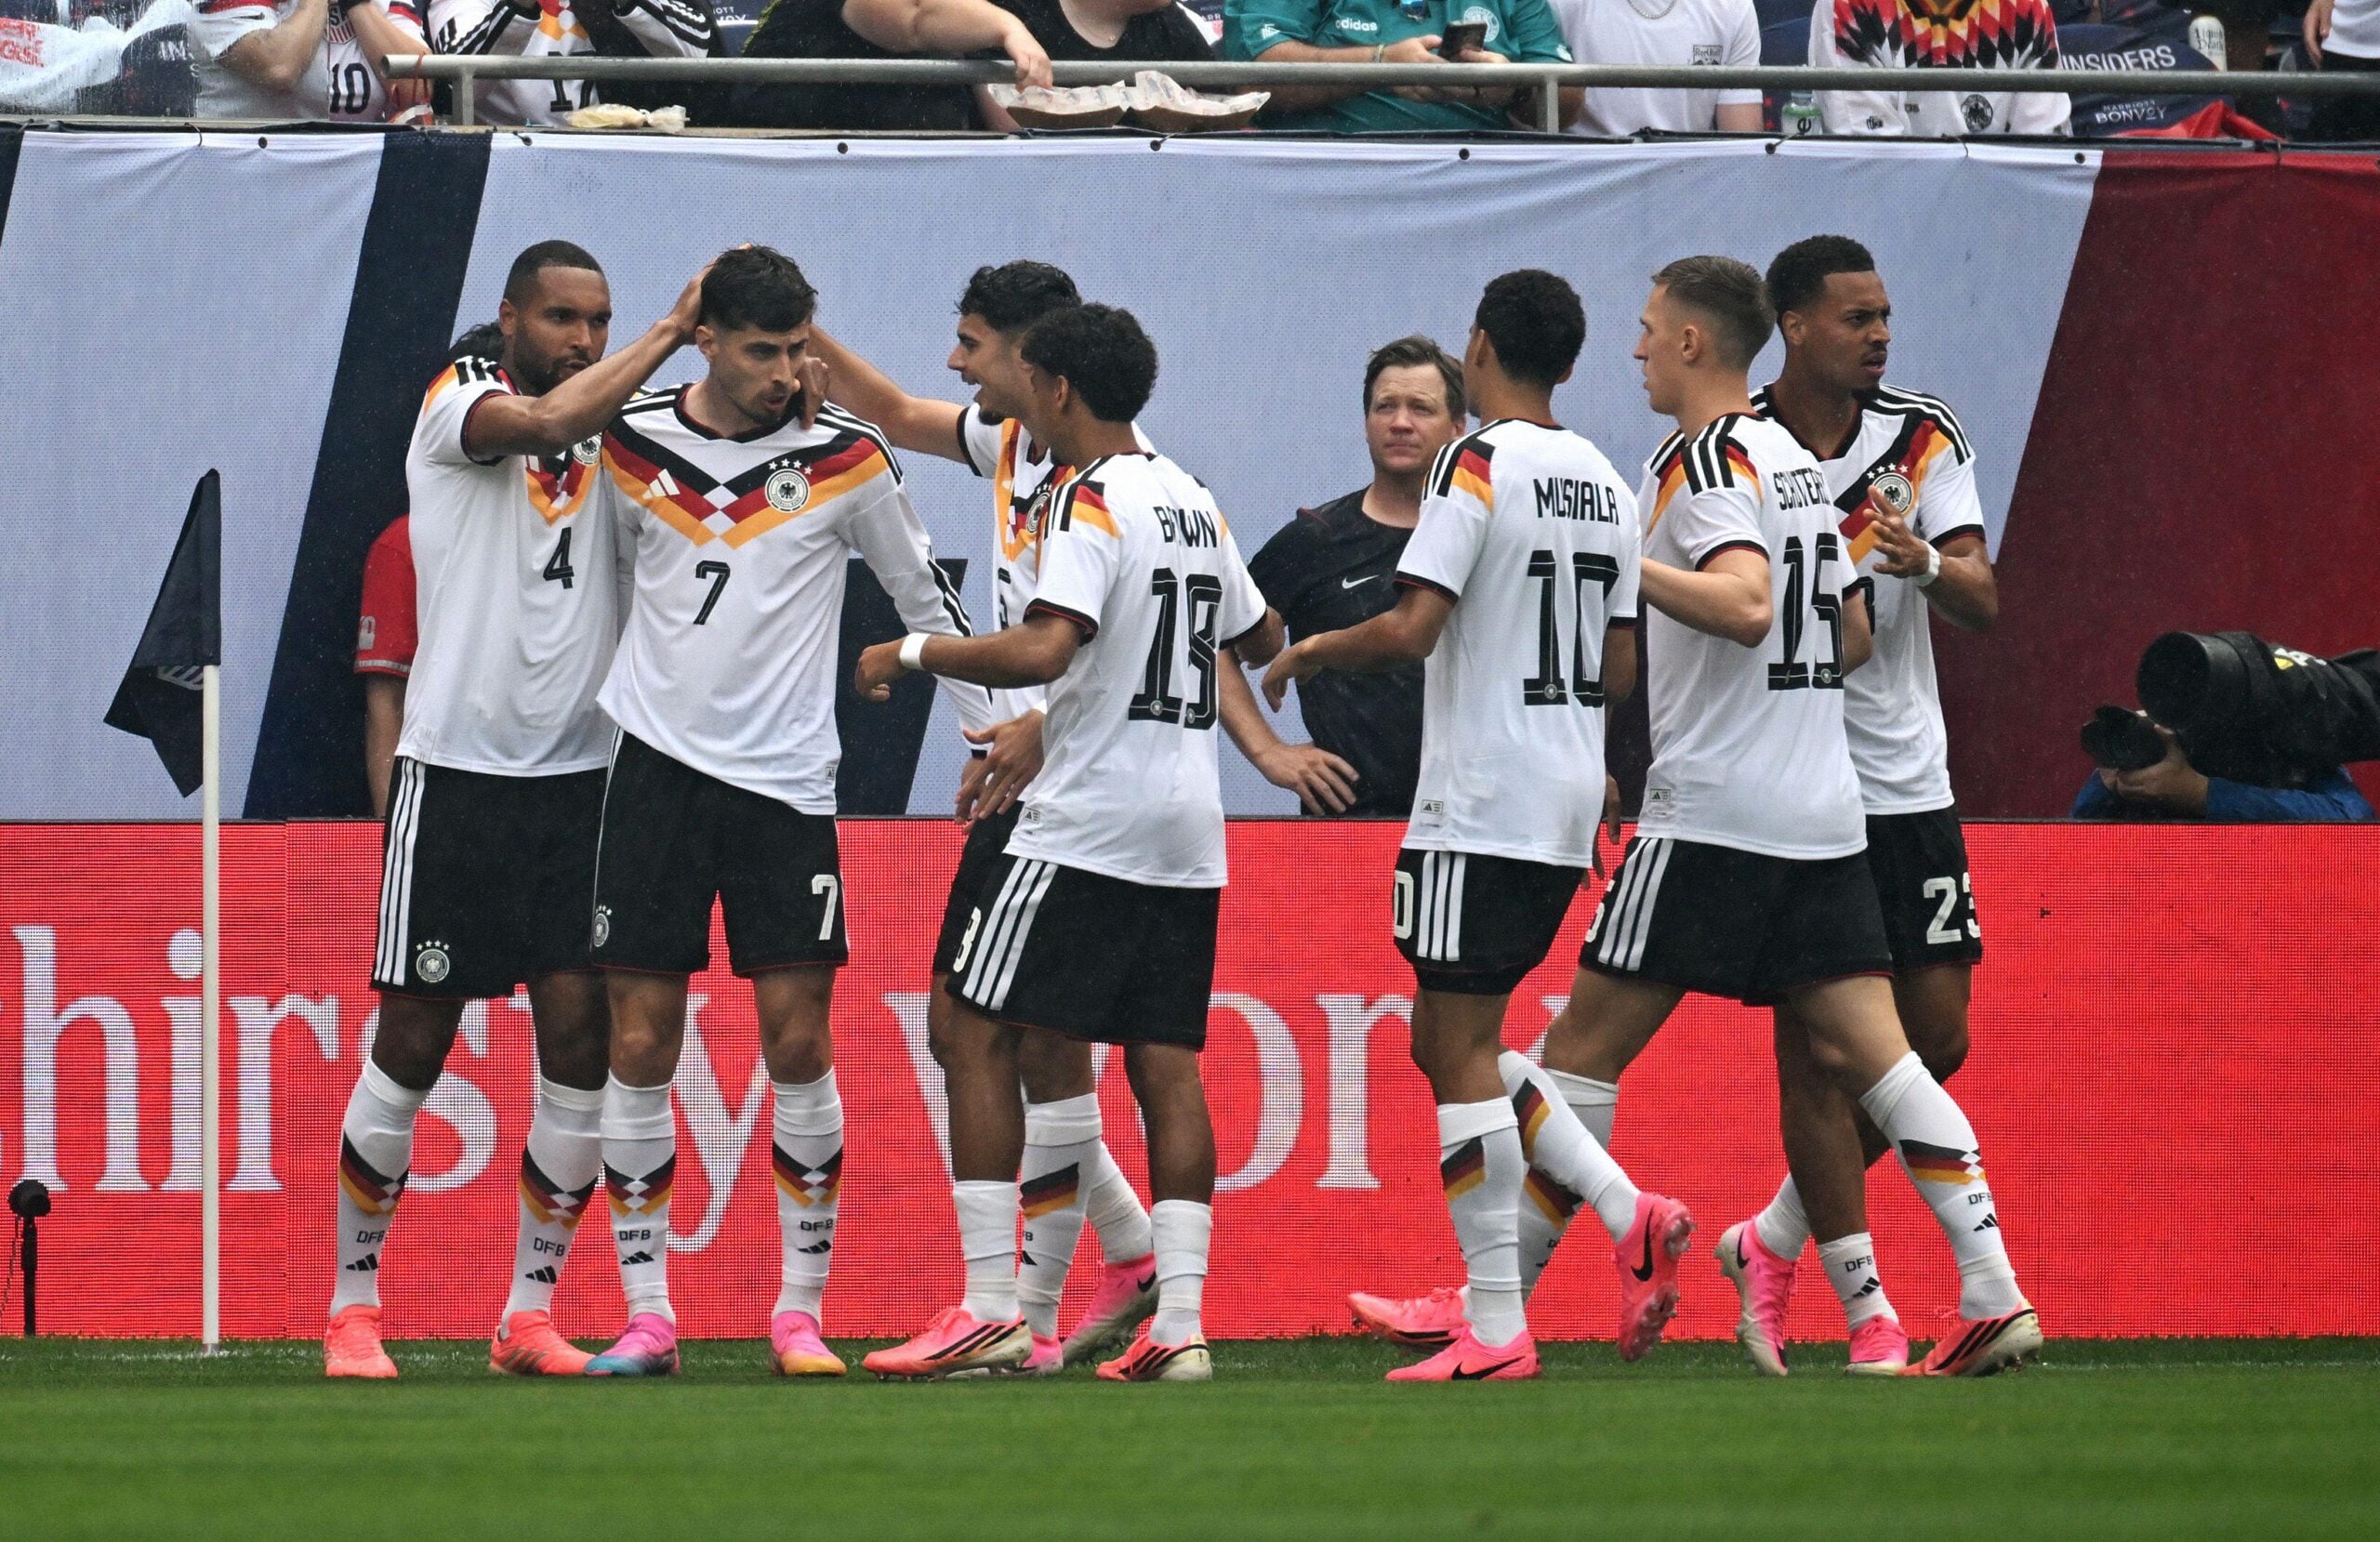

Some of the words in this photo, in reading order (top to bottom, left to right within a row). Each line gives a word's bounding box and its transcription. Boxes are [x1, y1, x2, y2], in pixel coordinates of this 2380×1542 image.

[1336, 19, 1378, 32] adidas
[2062, 46, 2176, 72] INSIDERS
[330, 62, 371, 114] 10
[2095, 106, 2165, 125] BONVOY
[1533, 477, 1620, 525] MUSIALA
[1153, 506, 1217, 547] BWN
[543, 526, 575, 589] 4
[693, 560, 731, 626] 7
[1767, 533, 1844, 691] 15
[1521, 548, 1620, 708] 10
[812, 874, 838, 941] 7
[619, 1230, 651, 1241] DFB
[800, 1219, 834, 1232] DFB
[534, 1237, 565, 1257] DFB
[1844, 1255, 1873, 1272] DFB
